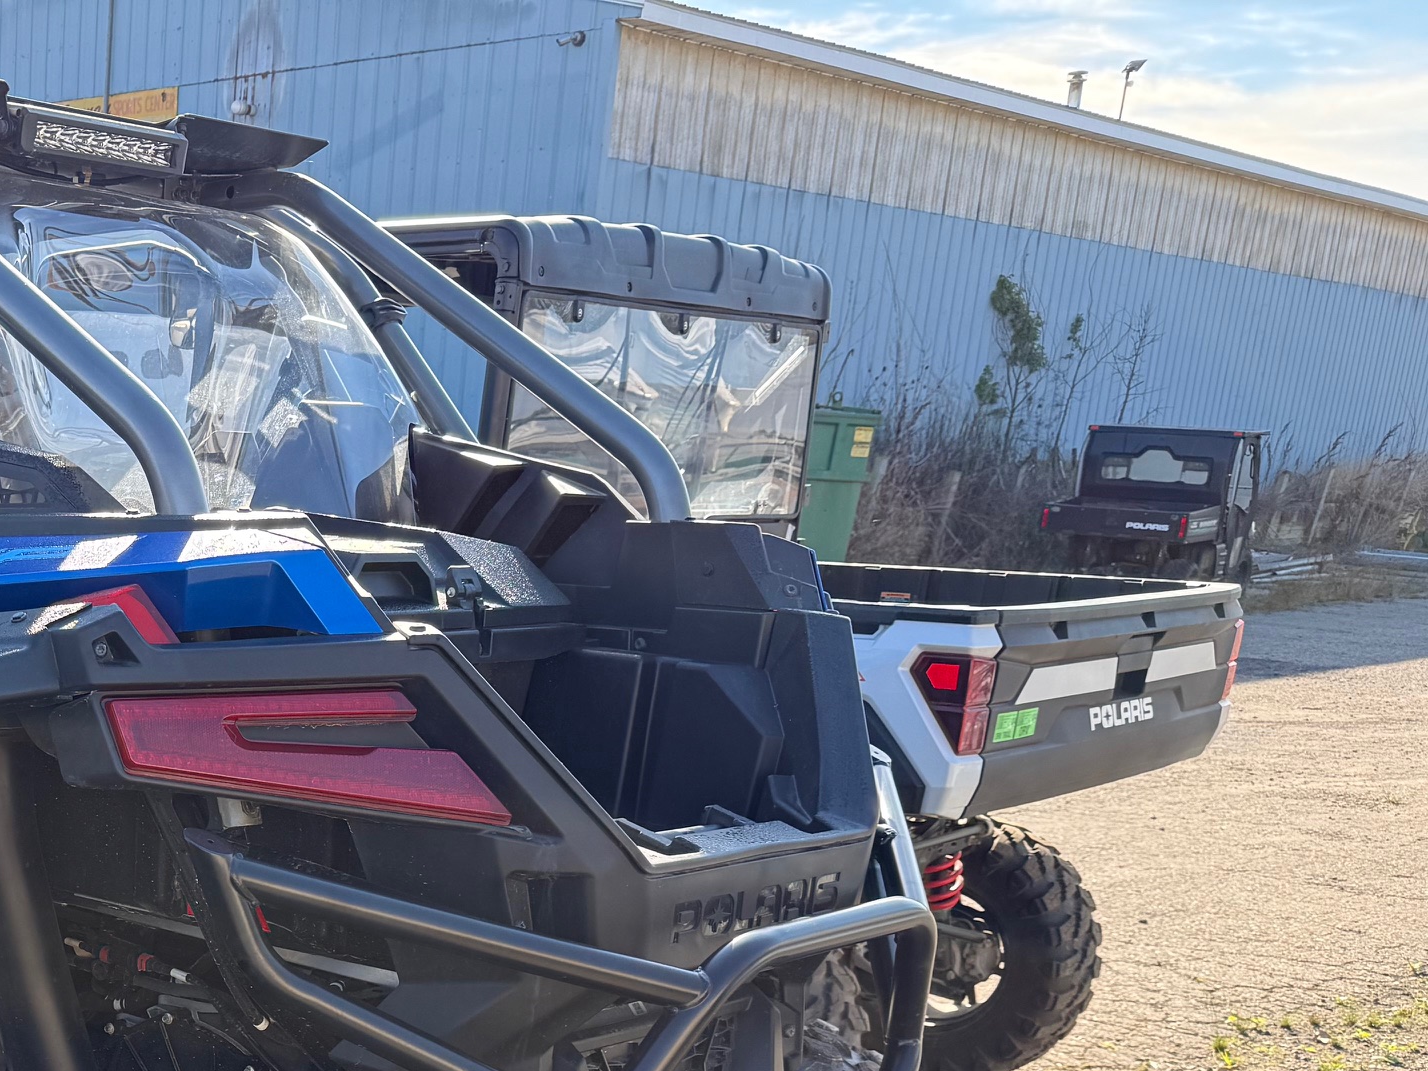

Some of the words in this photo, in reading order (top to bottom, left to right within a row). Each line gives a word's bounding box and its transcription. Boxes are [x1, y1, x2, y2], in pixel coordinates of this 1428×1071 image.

[145, 92, 177, 113] CENTER
[1125, 521, 1170, 532] POLARIS
[1088, 697, 1154, 731] POLARIS
[672, 871, 842, 945] POLARIS
